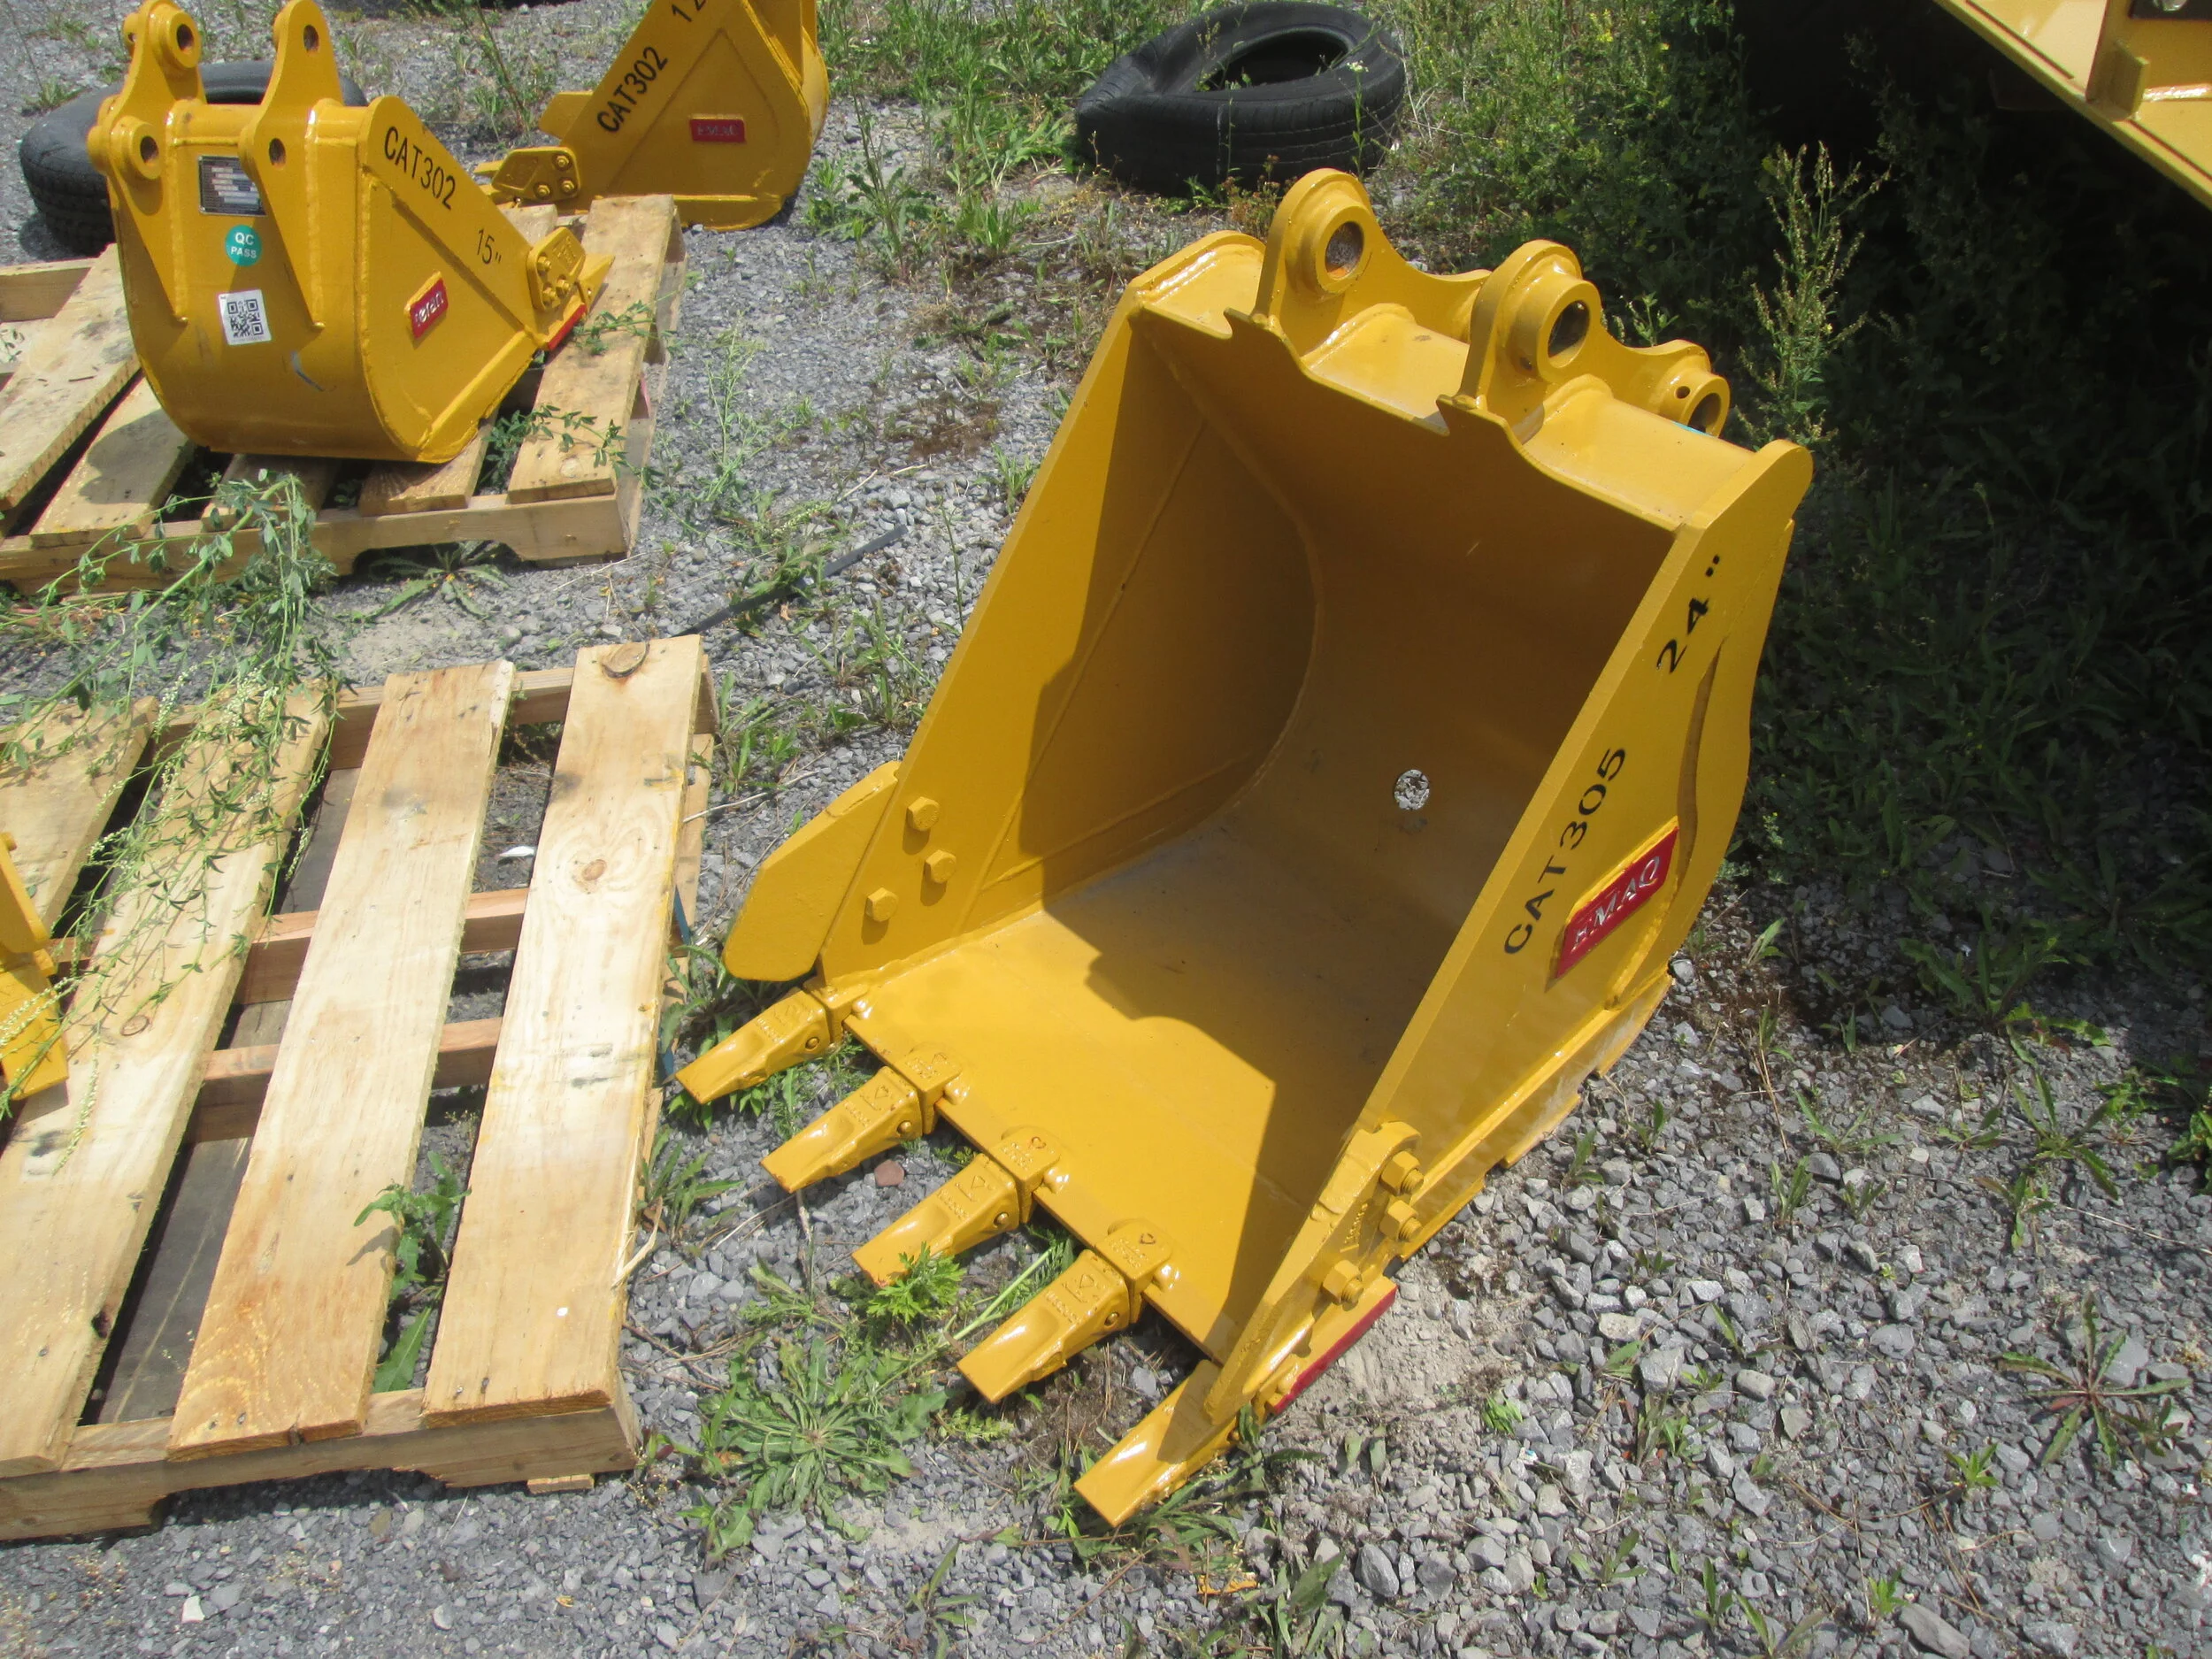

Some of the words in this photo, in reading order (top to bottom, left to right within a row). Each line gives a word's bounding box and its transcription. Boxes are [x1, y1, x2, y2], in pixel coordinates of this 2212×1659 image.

[596, 46, 668, 133] CAT302
[384, 126, 457, 211] CAT302
[230, 246, 257, 259] PASS
[234, 232, 254, 246] QC
[1504, 748, 1626, 955] CAT305
